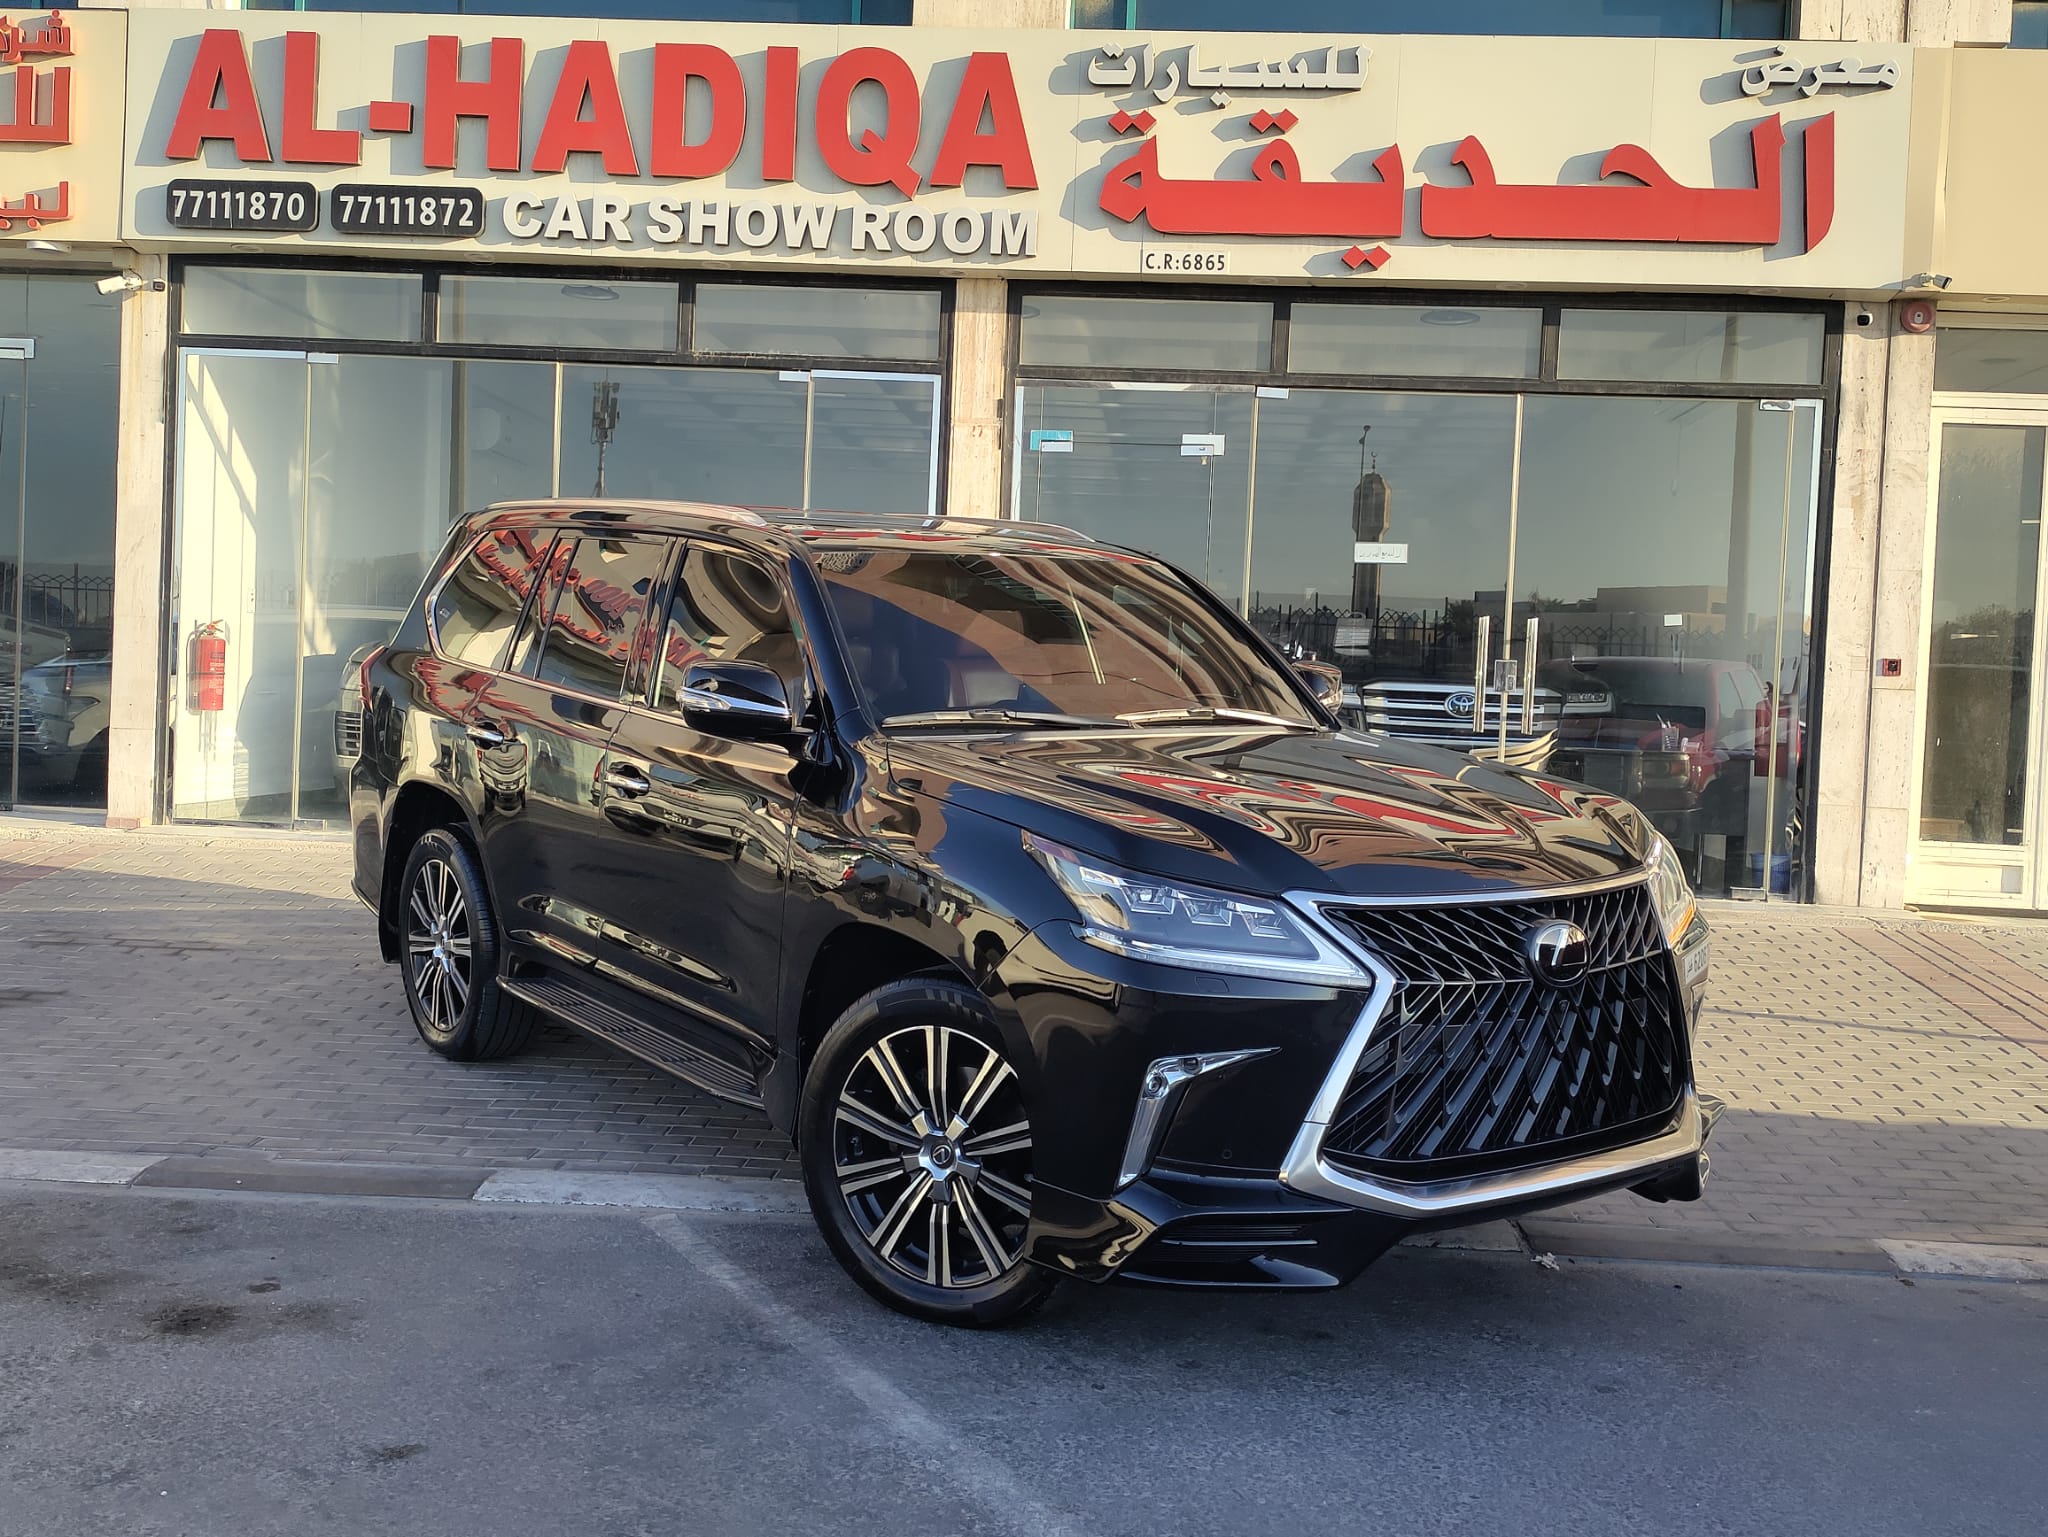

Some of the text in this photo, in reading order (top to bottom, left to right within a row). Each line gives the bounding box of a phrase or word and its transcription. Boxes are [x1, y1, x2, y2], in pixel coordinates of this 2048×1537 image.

[1087, 42, 1902, 109] معرض للسيارات
[165, 28, 1039, 201] AL-HADIQA
[171, 189, 306, 222] 77111870
[338, 194, 475, 227] 77111872
[1100, 109, 1835, 272] الحديقة
[502, 191, 1038, 257] CAR SHOW ROOM
[1145, 253, 1226, 271] C.R:6865
